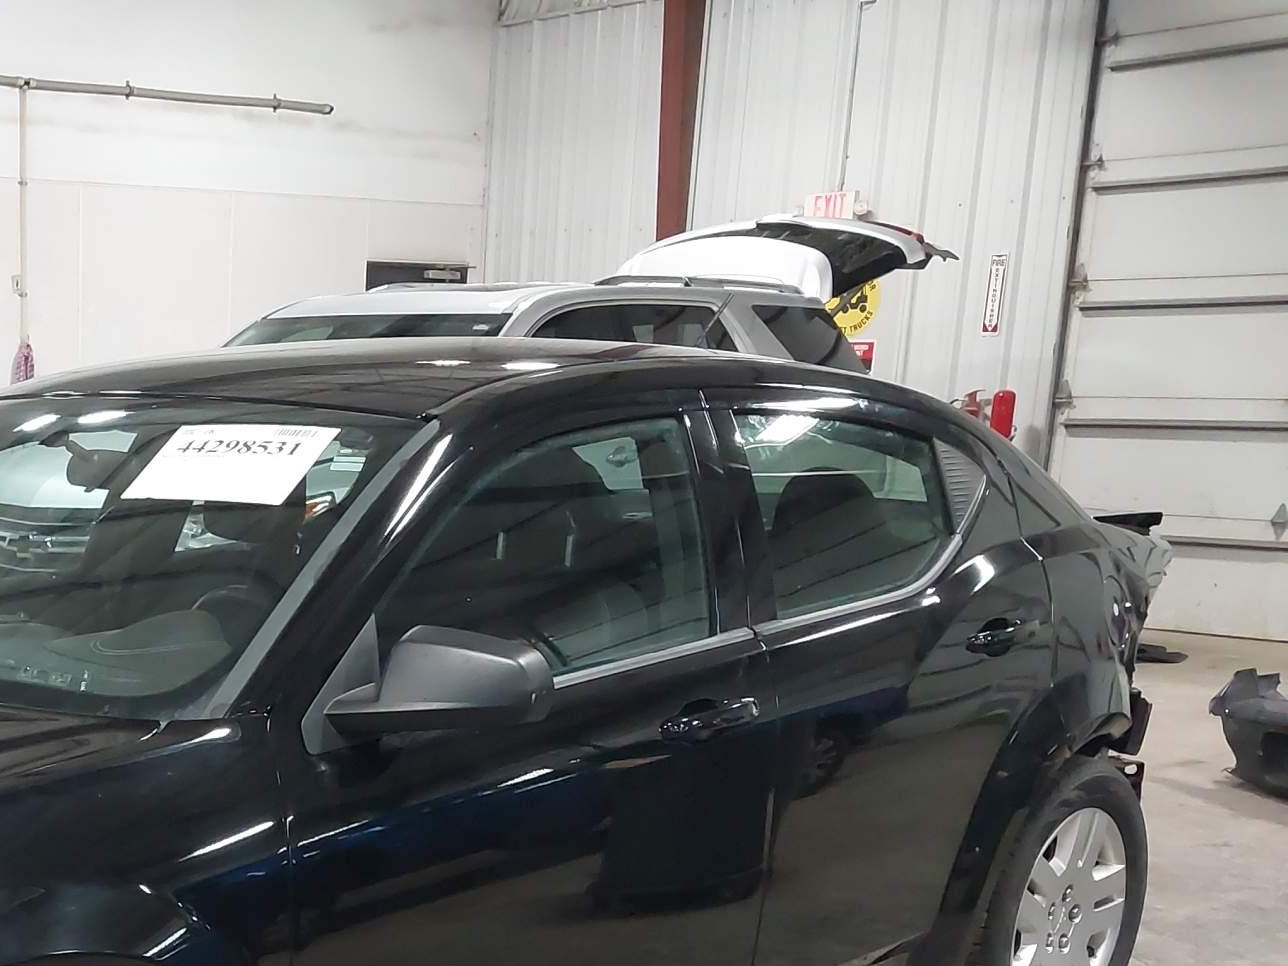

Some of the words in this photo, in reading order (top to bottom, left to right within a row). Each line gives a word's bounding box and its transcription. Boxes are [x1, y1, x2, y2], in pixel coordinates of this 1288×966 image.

[813, 192, 847, 218] EXIT
[992, 258, 1007, 267] FIRE
[849, 310, 873, 333] TRUCKS
[177, 439, 303, 456] 44298531
